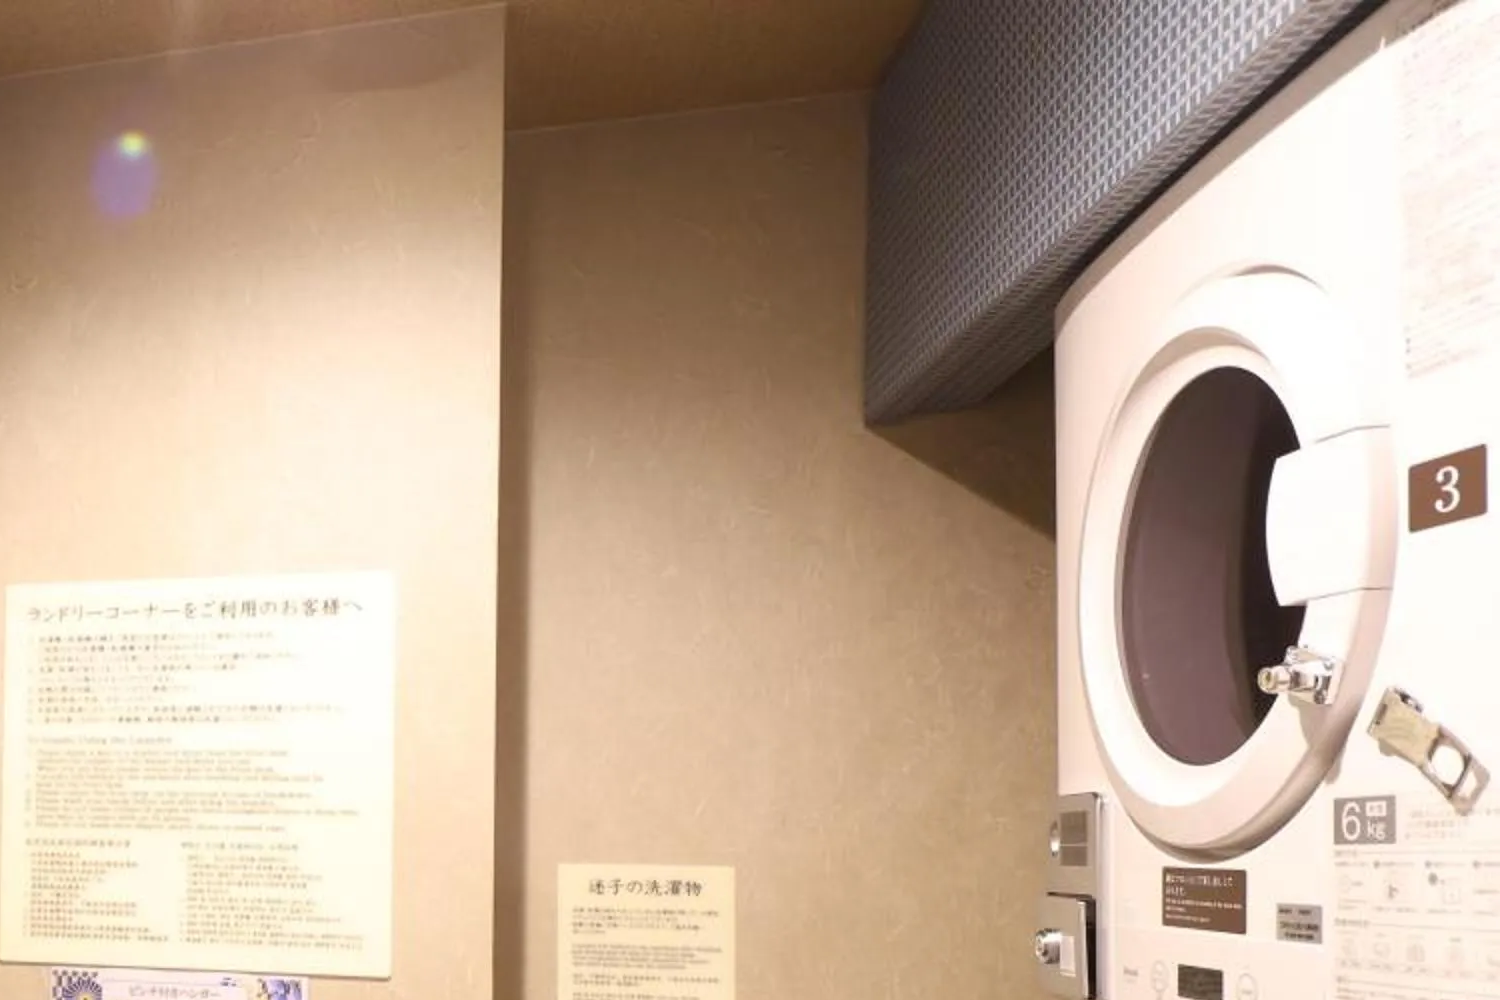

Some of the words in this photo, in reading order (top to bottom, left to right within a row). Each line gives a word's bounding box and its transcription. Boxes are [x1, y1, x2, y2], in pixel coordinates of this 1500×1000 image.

[1434, 466, 1461, 513] 3
[27, 596, 364, 623] ランドリーコーナーをご利用のお客様へ
[1341, 801, 1361, 841] 6
[1367, 822, 1386, 841] kg
[589, 877, 704, 898] 迷子の洗濯物
